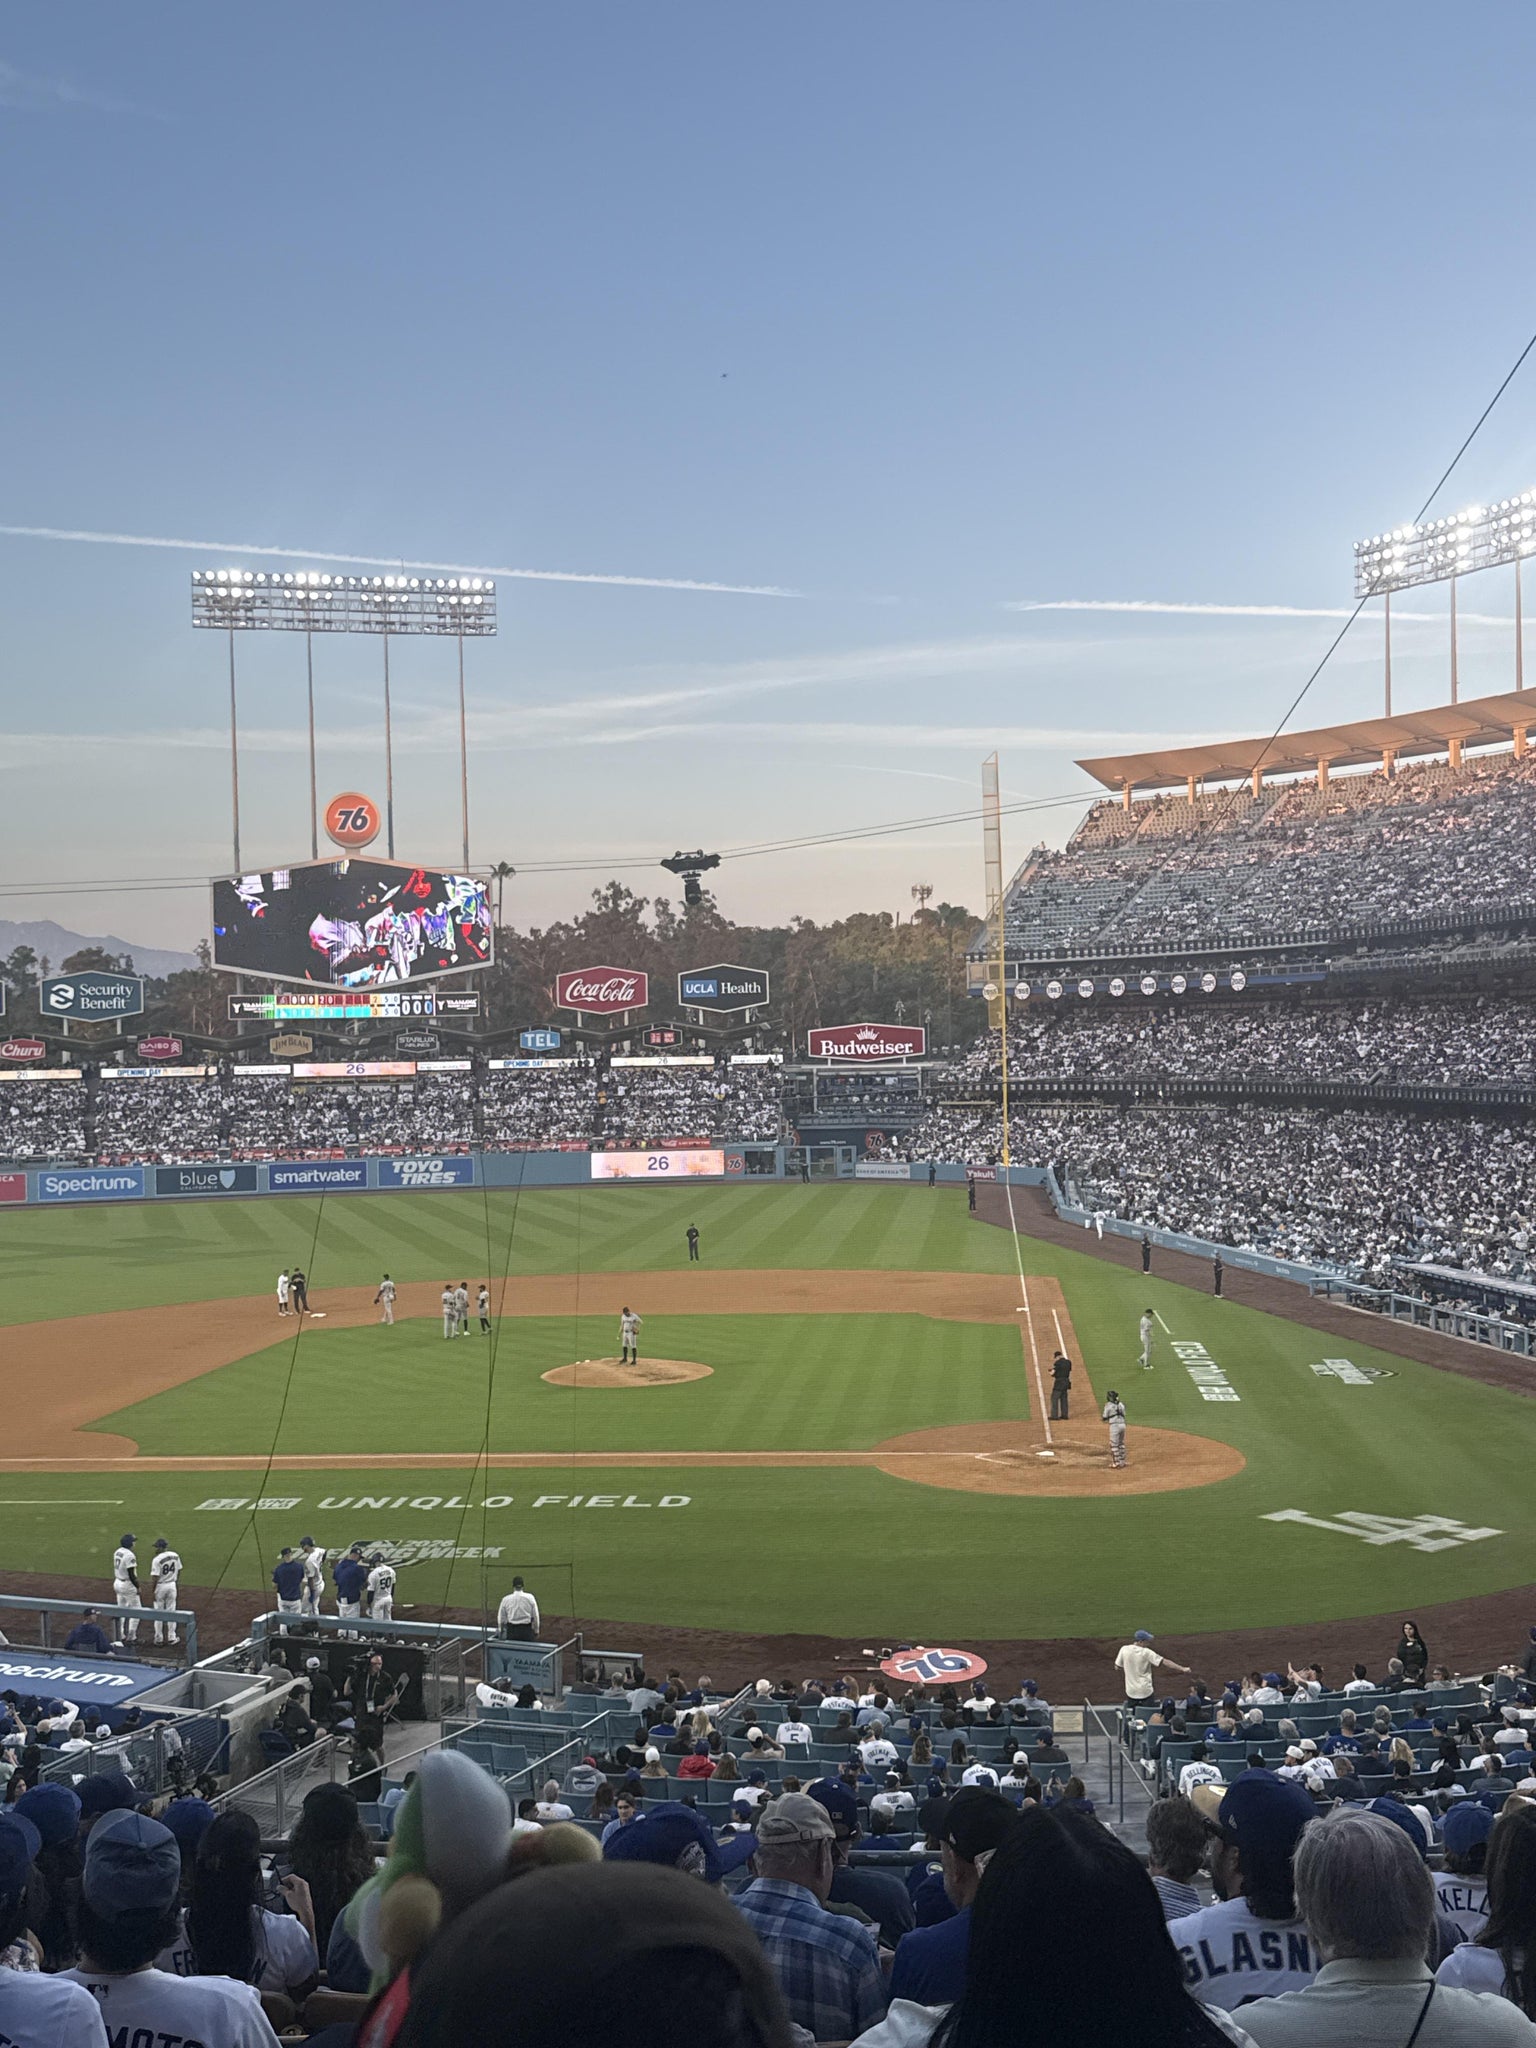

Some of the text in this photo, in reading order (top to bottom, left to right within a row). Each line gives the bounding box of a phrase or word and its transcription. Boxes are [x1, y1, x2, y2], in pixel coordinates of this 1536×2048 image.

[335, 805, 370, 832] 76
[80, 983, 134, 998] Security
[565, 977, 639, 1003] Coca-Cola
[685, 982, 761, 994] UCLA Health
[81, 997, 126, 1010] Benefit
[273, 1039, 287, 1052] JIM
[525, 1033, 555, 1047] TEL
[1, 1044, 43, 1056] Churu
[820, 1040, 914, 1056] Budweiser
[345, 1064, 365, 1074] 26
[870, 1135, 884, 1147] 76
[391, 1160, 443, 1173] TOYO
[647, 1156, 669, 1171] 26
[727, 1158, 742, 1168] 76
[180, 1171, 217, 1186] blue
[274, 1168, 361, 1184] smartwater
[401, 1171, 456, 1185] TIRES
[46, 1176, 132, 1196] Spectrum
[317, 1495, 692, 1509] UNIQLO FIELD
[416, 1547, 506, 1558] WEEK
[162, 1562, 176, 1575] 84
[379, 1576, 392, 1590] 50
[895, 1649, 972, 1682] 76
[1179, 1931, 1322, 1985] GLASN
